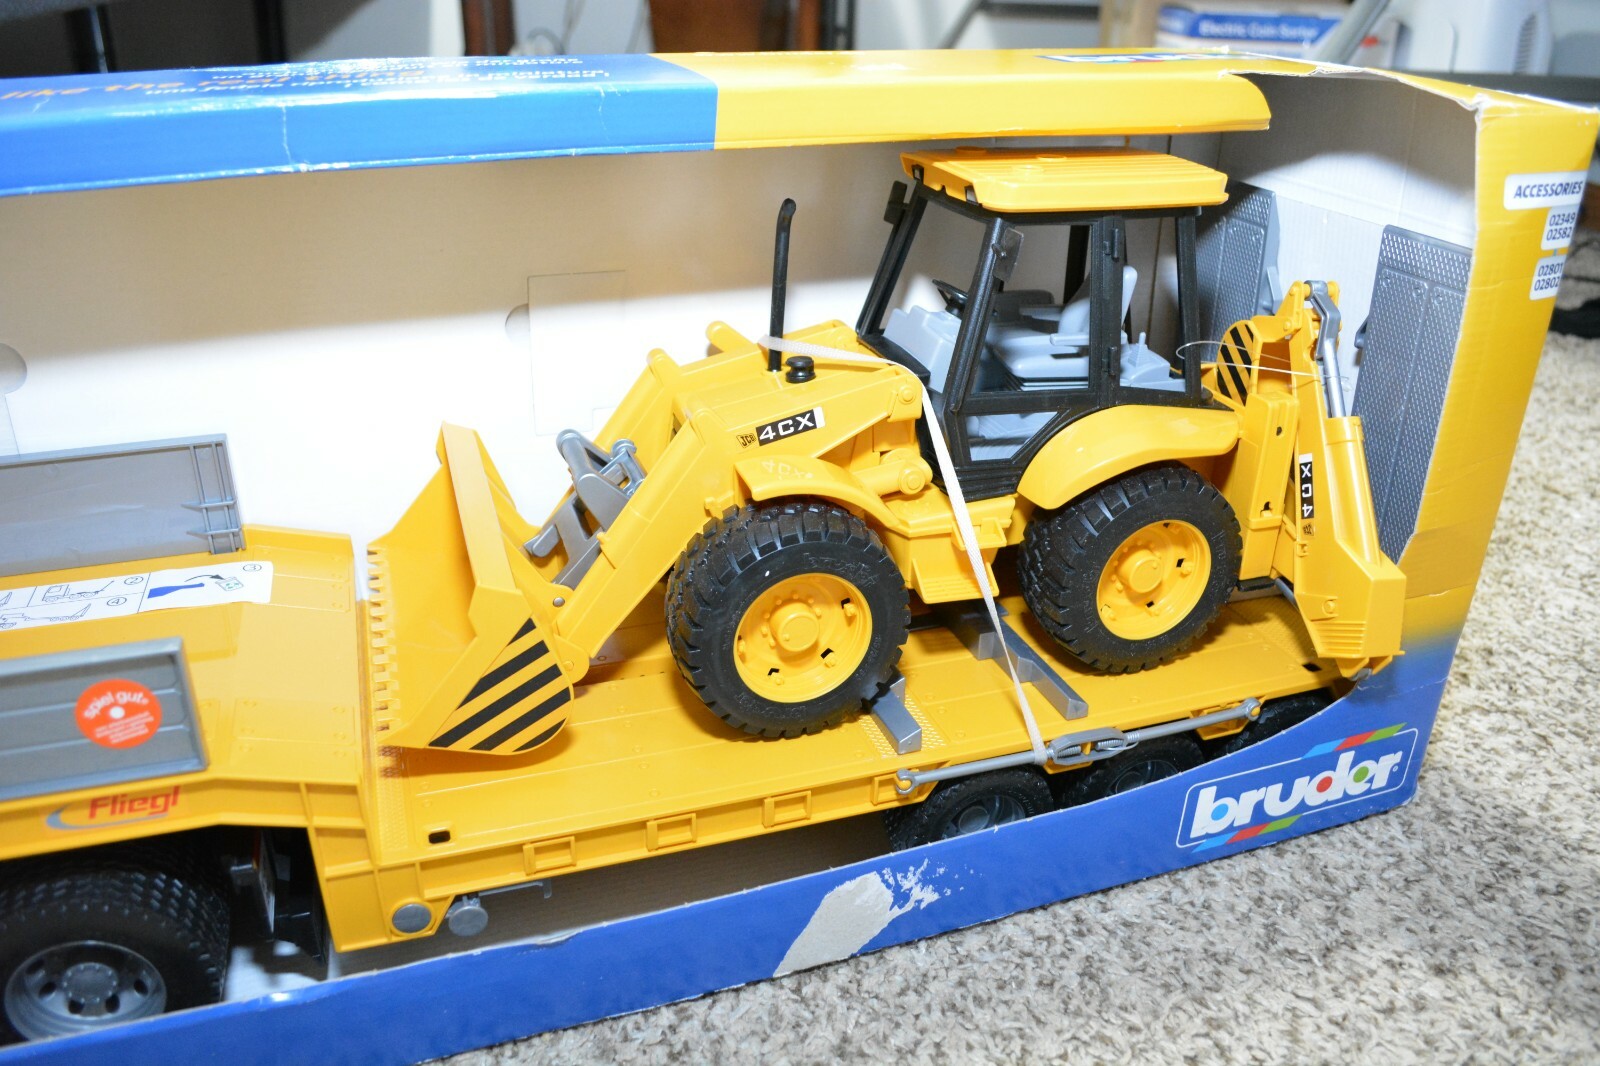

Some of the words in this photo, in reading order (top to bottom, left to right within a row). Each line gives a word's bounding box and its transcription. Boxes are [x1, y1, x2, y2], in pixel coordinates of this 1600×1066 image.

[1513, 181, 1583, 199] ACCESSORIES
[1548, 212, 1576, 226] 02349
[1545, 226, 1572, 241] 02582
[1537, 262, 1564, 277] 02801
[1533, 277, 1560, 291] 02802
[740, 434, 756, 447] JCB
[759, 412, 815, 440] 4CX
[1300, 463, 1313, 518] 4CX
[88, 785, 181, 820] Fliegl
[1189, 750, 1403, 839] bruder
